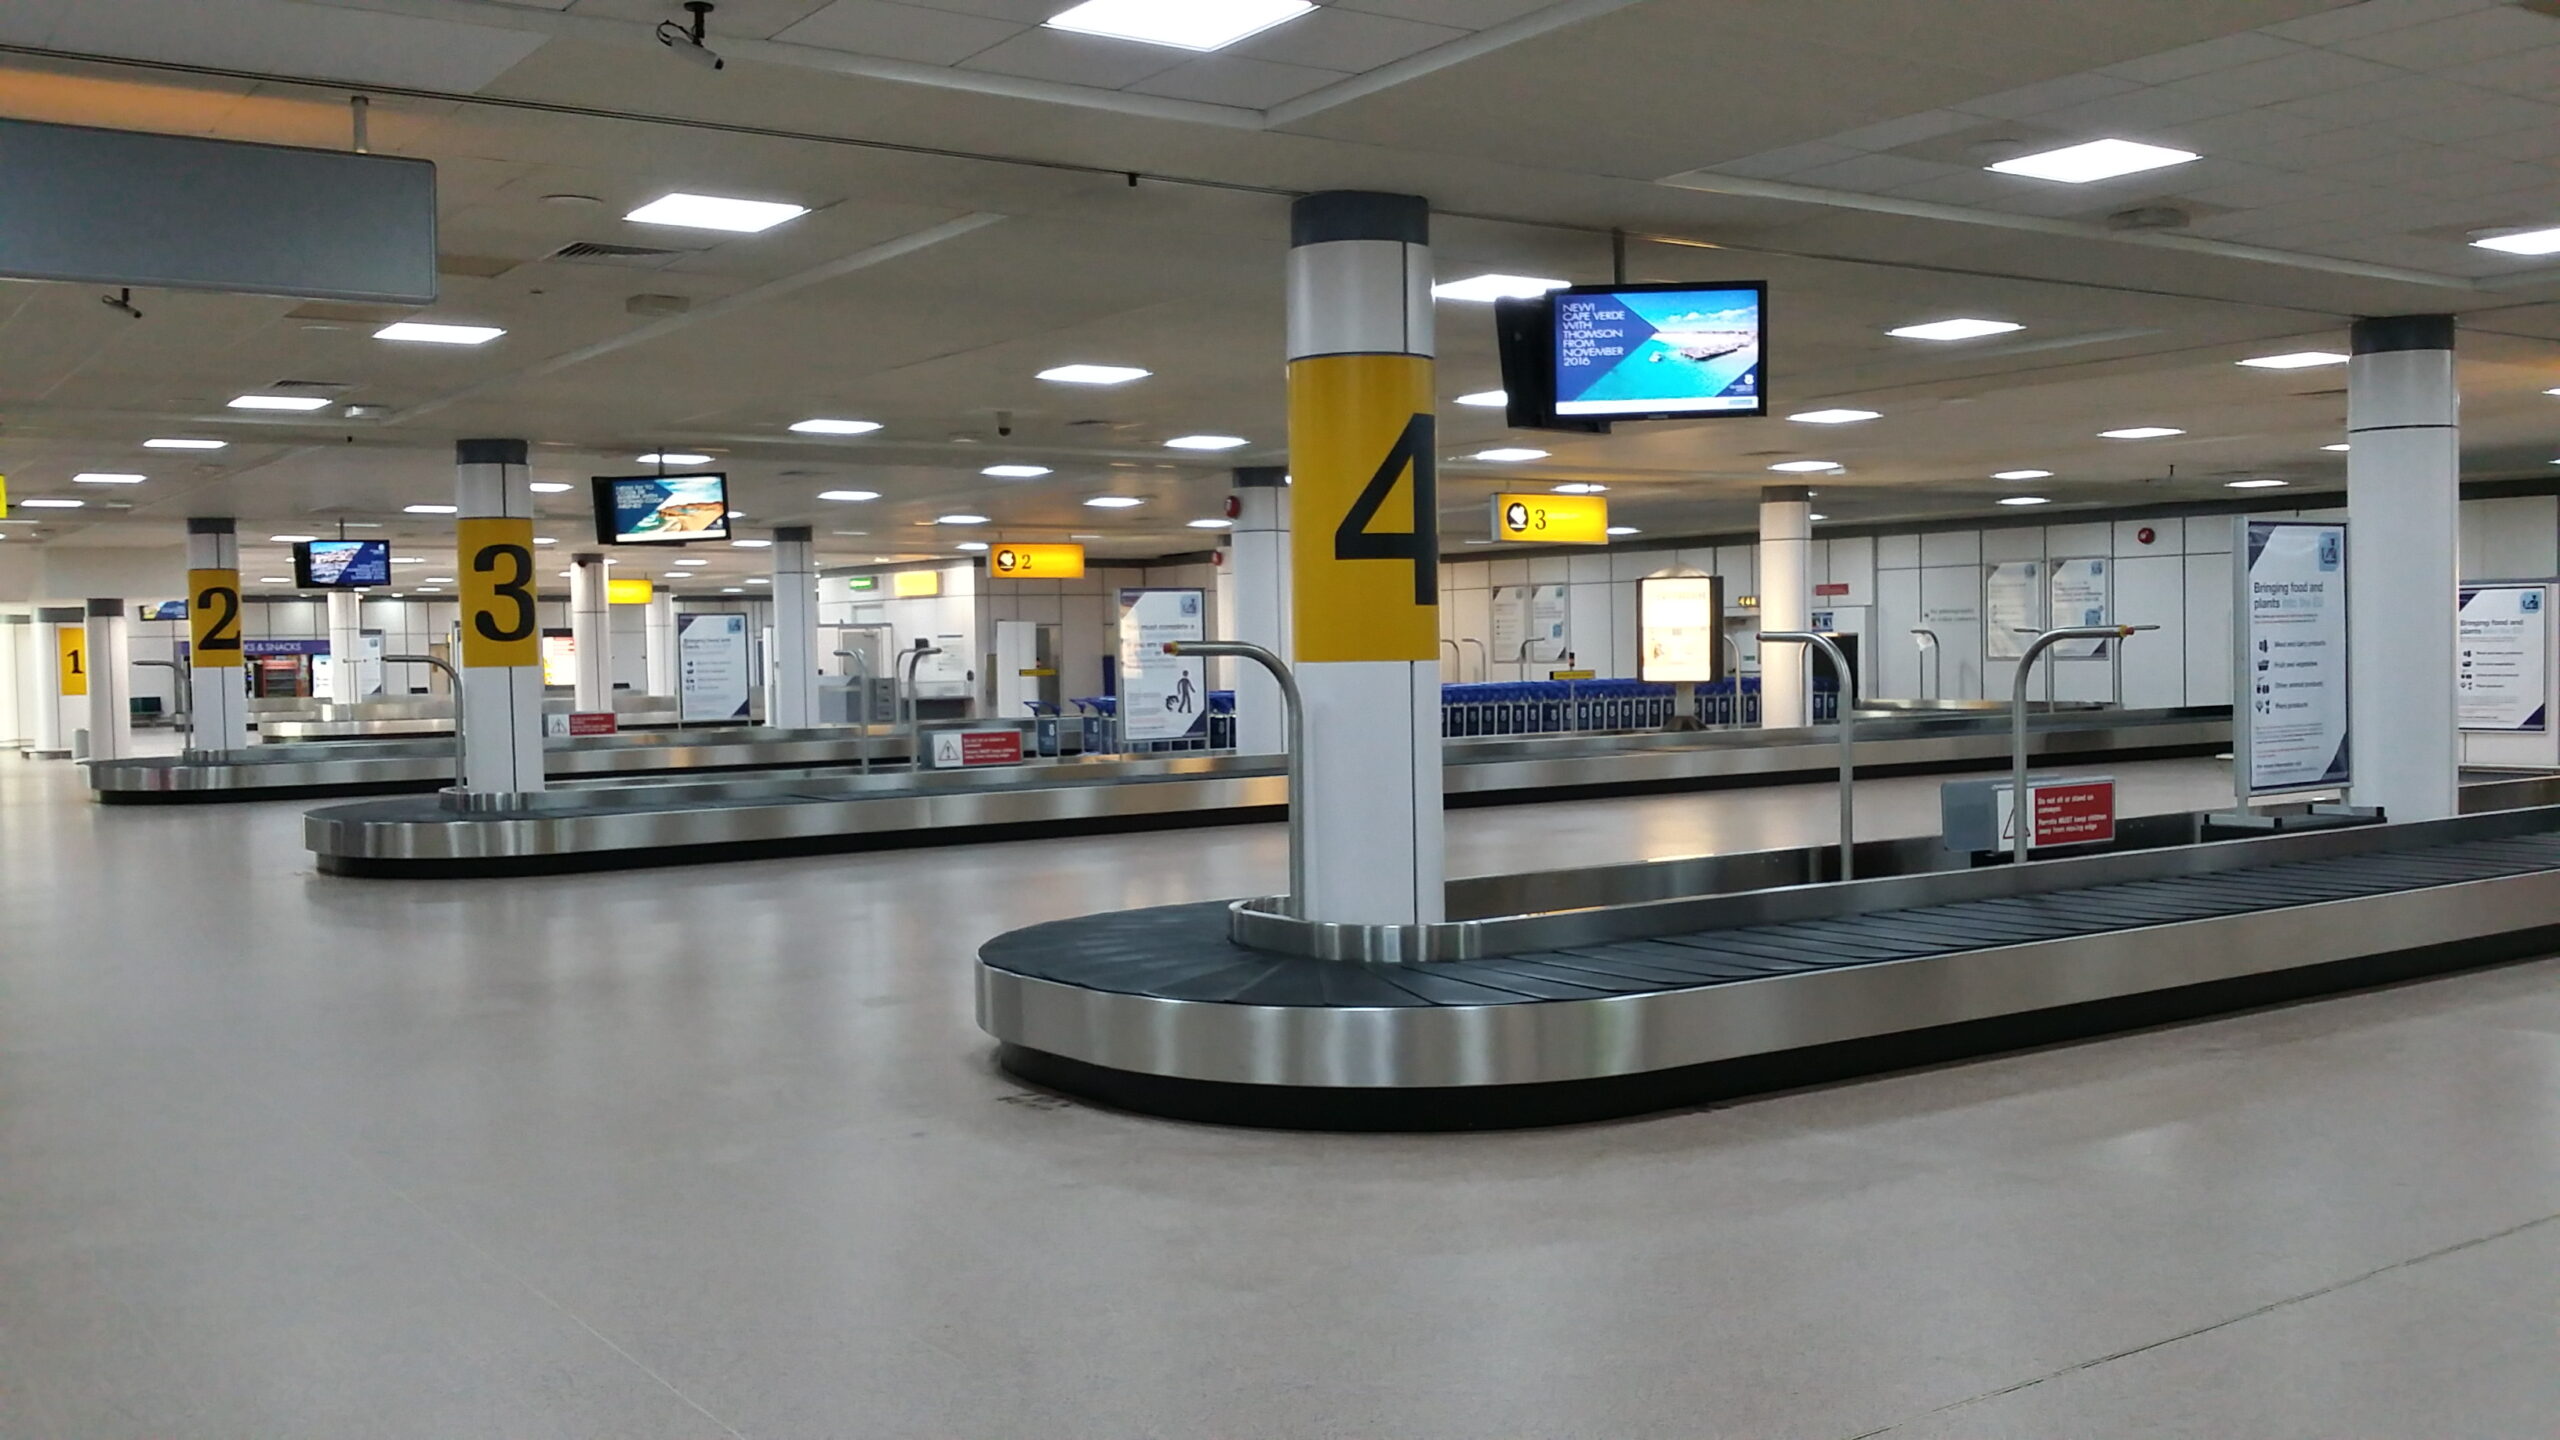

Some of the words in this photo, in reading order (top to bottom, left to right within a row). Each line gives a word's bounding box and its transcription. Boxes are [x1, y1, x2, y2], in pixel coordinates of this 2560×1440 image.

[1562, 312, 1590, 321] CAPE
[1593, 311, 1625, 320] VERDE
[1562, 321, 1592, 329] WITH
[1563, 329, 1623, 338] THOMSON
[1563, 339, 1595, 348] FROM
[1563, 347, 1624, 357] NOVEMBER
[1563, 357, 1591, 366] 2016
[1335, 413, 1438, 605] 4
[1535, 509, 1546, 530] 3
[1021, 554, 1032, 569] 2
[474, 544, 535, 641] 3
[2254, 582, 2288, 595] Bringing
[2290, 581, 2309, 592] food
[2309, 581, 2324, 592] and
[2254, 598, 2280, 611] plants
[198, 587, 240, 650] 2
[265, 642, 301, 651] SNACKS
[67, 649, 85, 674] 1
